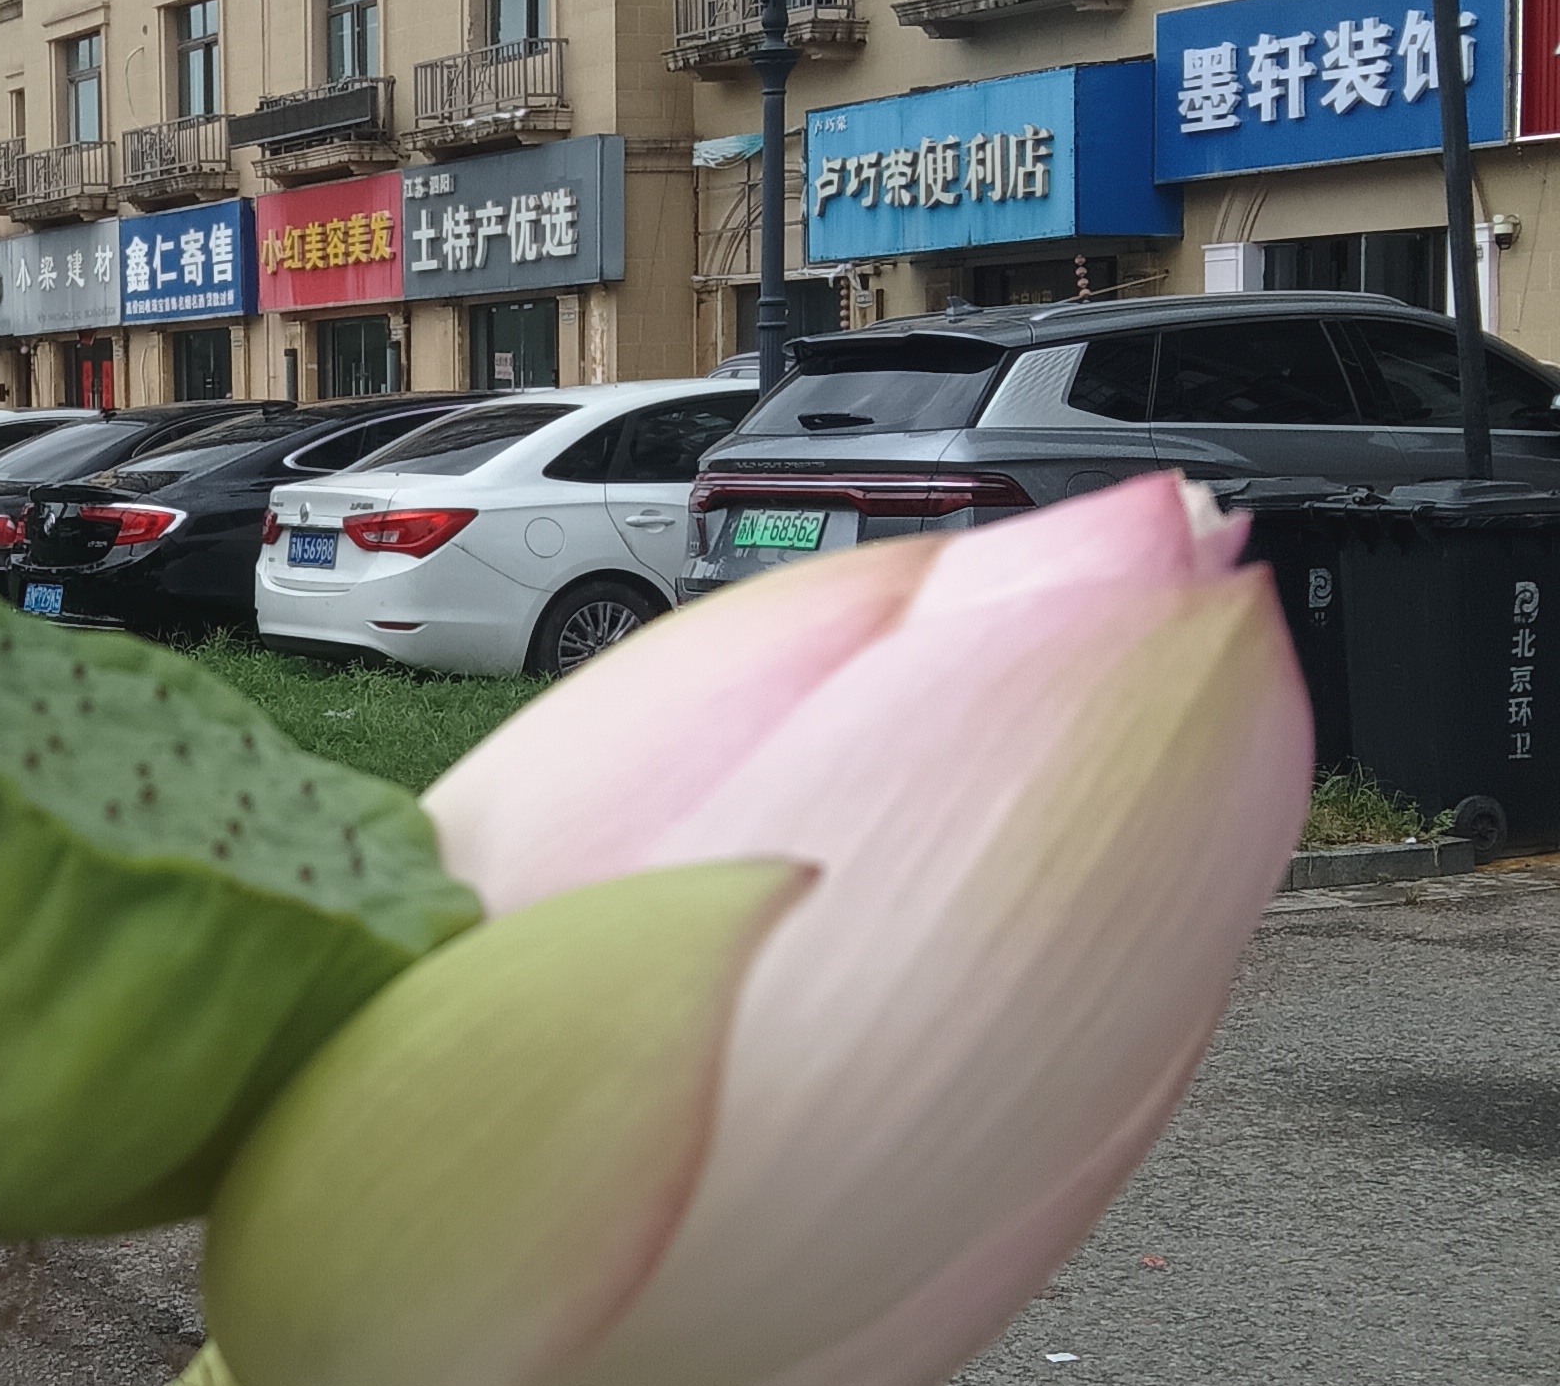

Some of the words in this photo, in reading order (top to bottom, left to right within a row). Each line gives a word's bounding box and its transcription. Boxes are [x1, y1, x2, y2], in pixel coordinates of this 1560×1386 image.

[1178, 9, 1478, 133] 墨轩装饰
[814, 123, 1054, 218] 卢巧荣便利店
[16, 244, 114, 293] 小梁建材
[125, 222, 233, 293] 鑫仁寄售
[261, 211, 394, 275] 小红美容美发
[411, 188, 577, 272] 土特产优选
[1508, 628, 1536, 759] 北京环卫
